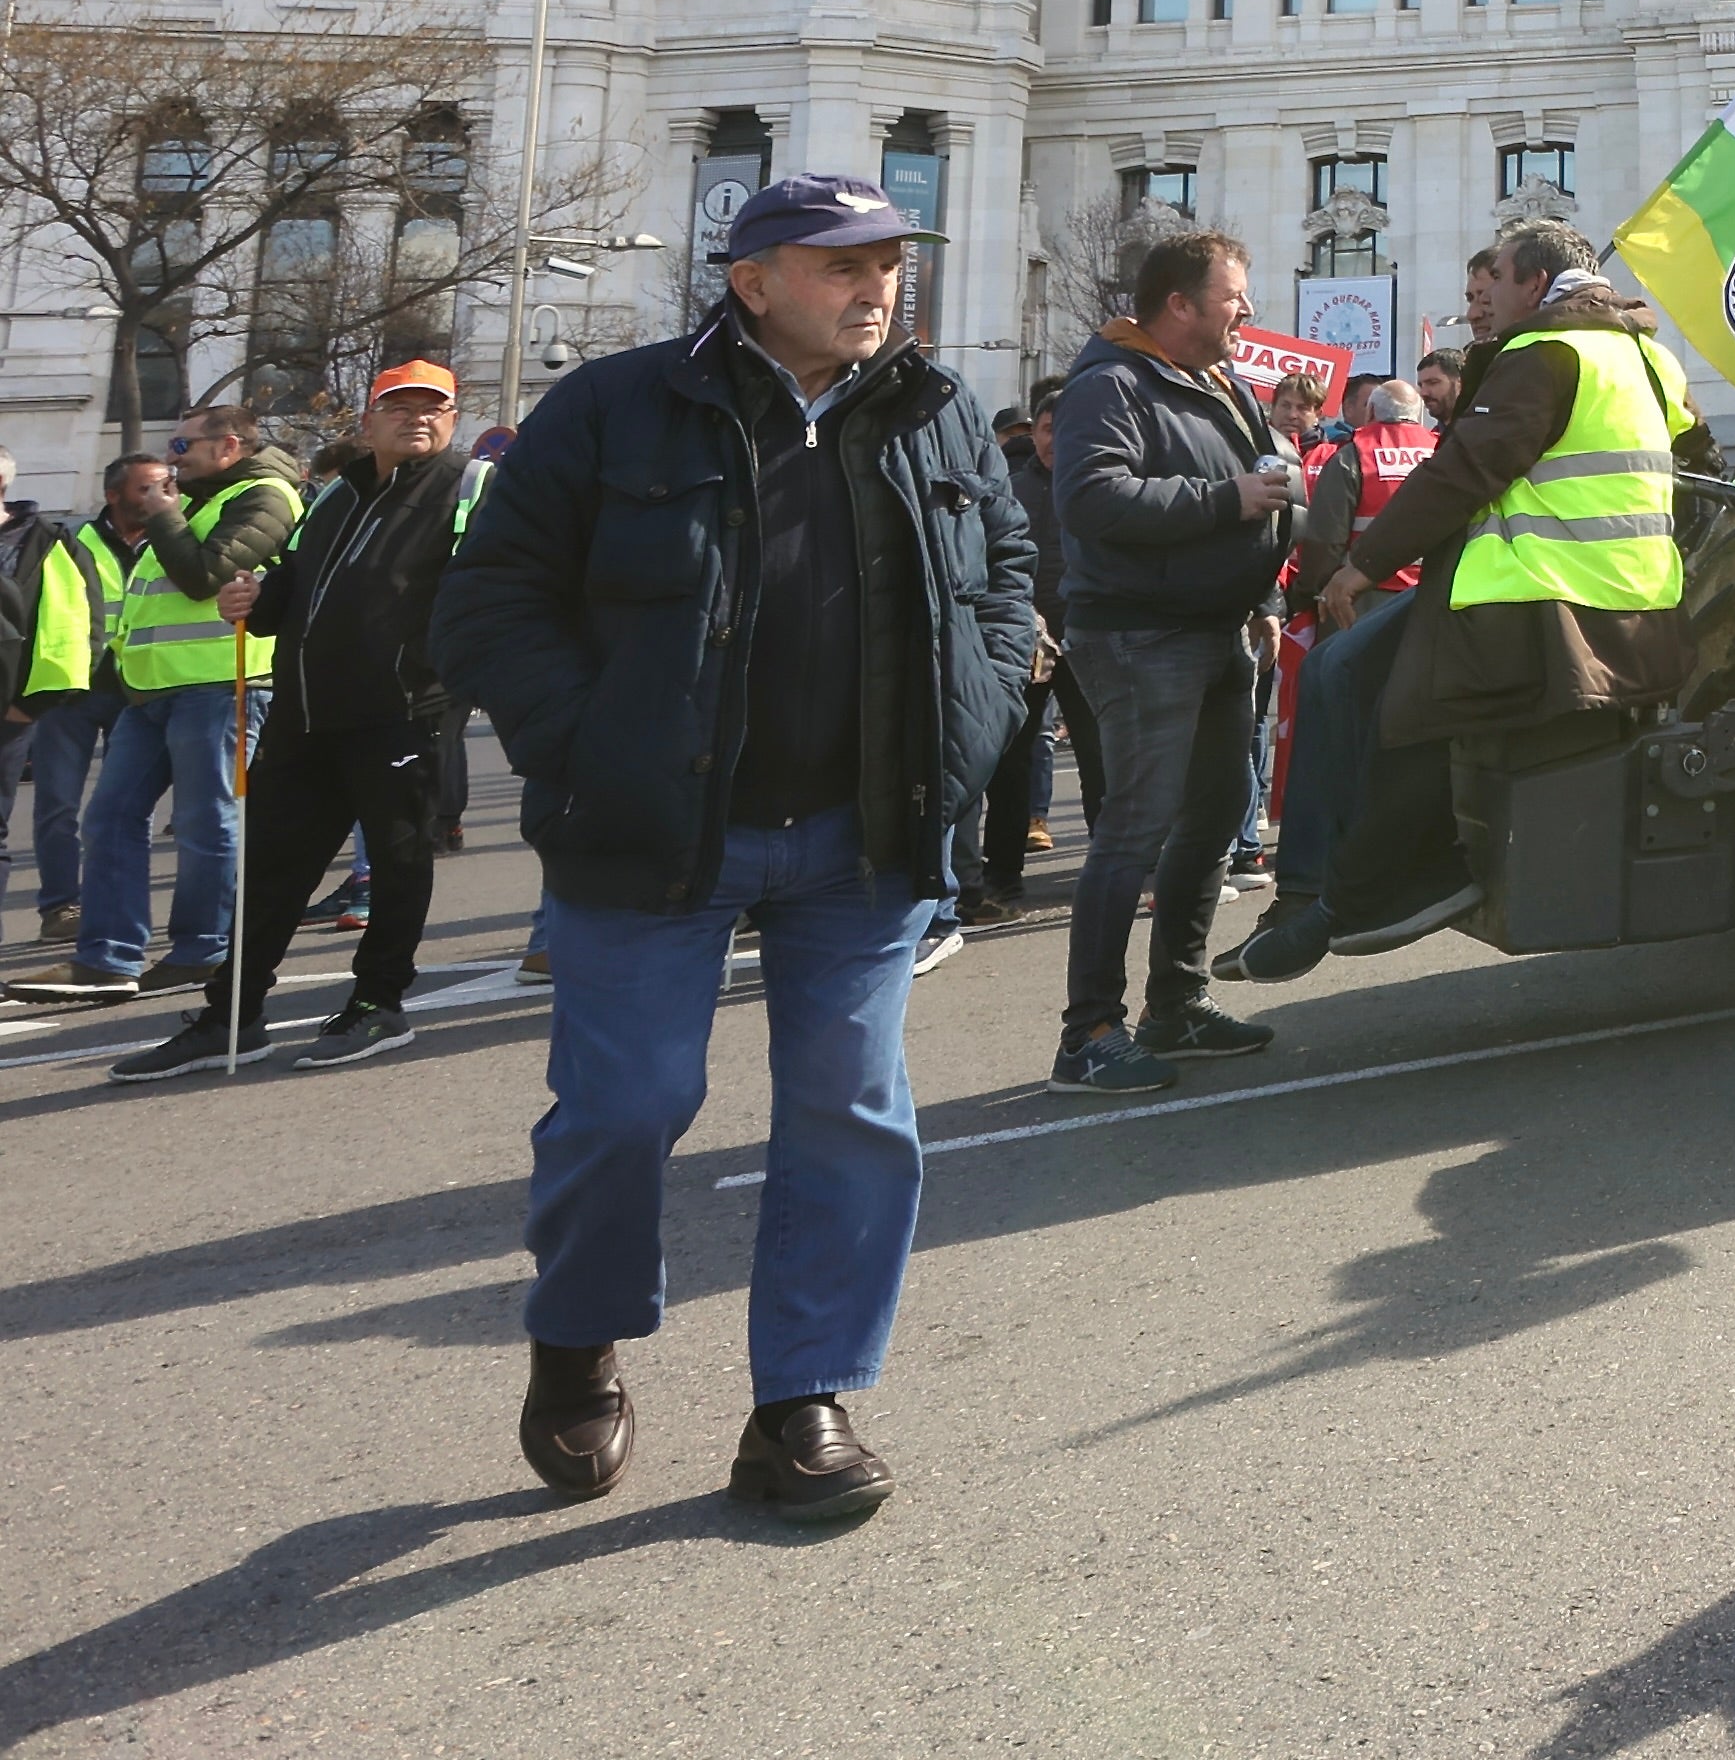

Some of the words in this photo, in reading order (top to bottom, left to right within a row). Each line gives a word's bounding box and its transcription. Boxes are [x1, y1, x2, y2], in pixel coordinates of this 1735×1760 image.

[1312, 310, 1324, 323] VA
[1323, 302, 1331, 312] A
[1332, 294, 1372, 312] QUEDAR
[1369, 311, 1381, 338] NADA
[1234, 342, 1330, 381] UAGN
[1356, 340, 1380, 350] ESTO
